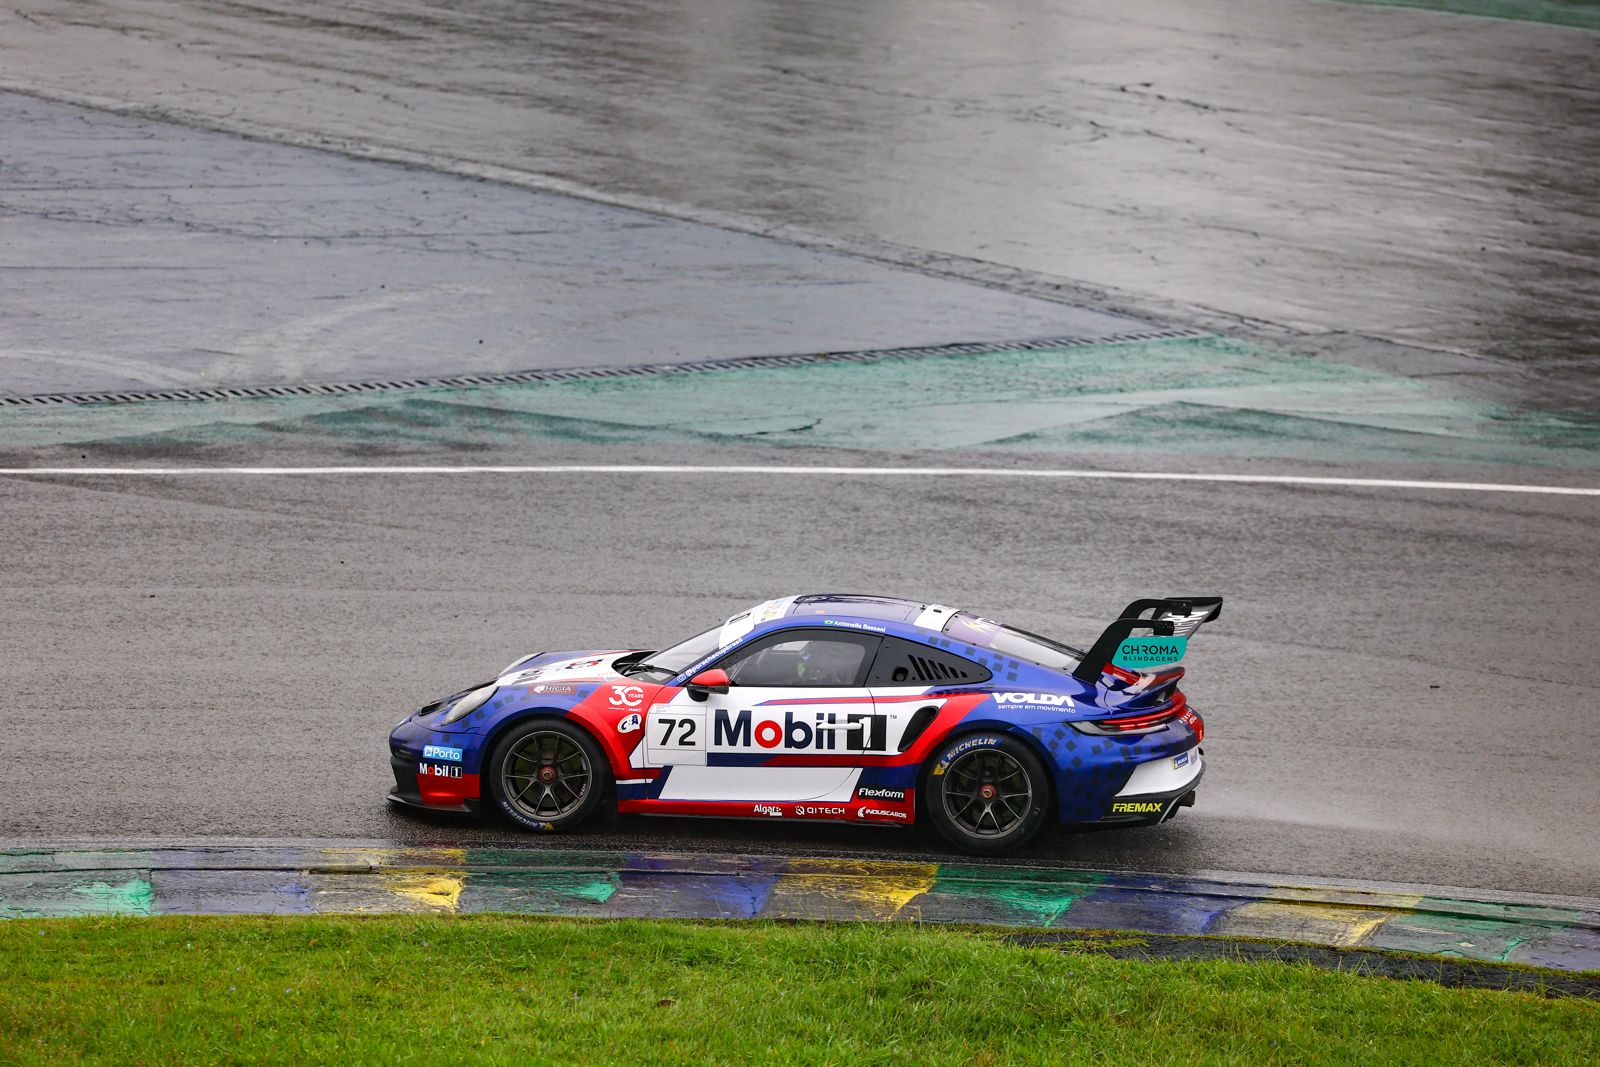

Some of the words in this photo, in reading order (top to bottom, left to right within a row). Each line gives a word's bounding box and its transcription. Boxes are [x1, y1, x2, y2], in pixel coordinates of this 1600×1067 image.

[834, 620, 861, 628] Antonella
[1122, 645, 1179, 655] CHROMA
[992, 692, 1075, 707] VOLDA
[1037, 705, 1076, 714] movimento
[658, 718, 696, 746] 72
[714, 709, 836, 750] Mobil
[433, 747, 460, 759] Porto
[946, 738, 997, 760] MICHELIN
[420, 762, 448, 777] Mobil
[858, 788, 904, 799] Flexform
[1112, 803, 1163, 813] FREMAX
